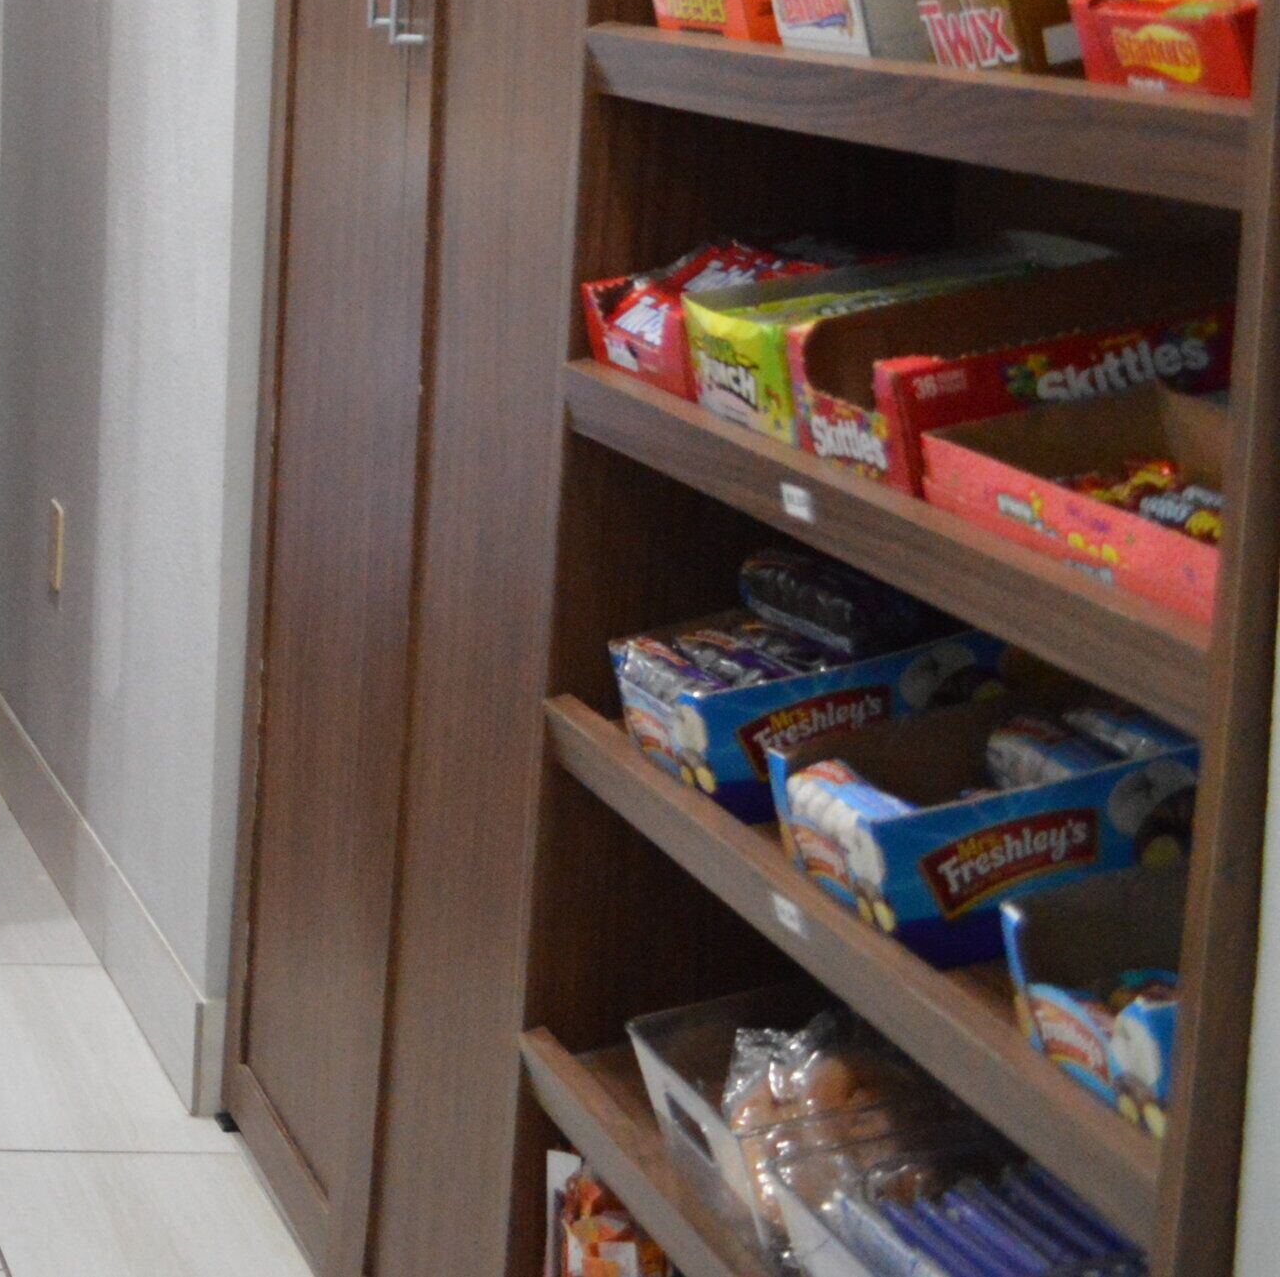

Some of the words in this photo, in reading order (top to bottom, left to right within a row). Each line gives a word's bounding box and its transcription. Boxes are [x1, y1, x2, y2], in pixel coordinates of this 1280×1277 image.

[1037, 338, 1210, 401] Skittles
[809, 414, 887, 471] Skittles
[938, 818, 1088, 895] Freshley's
